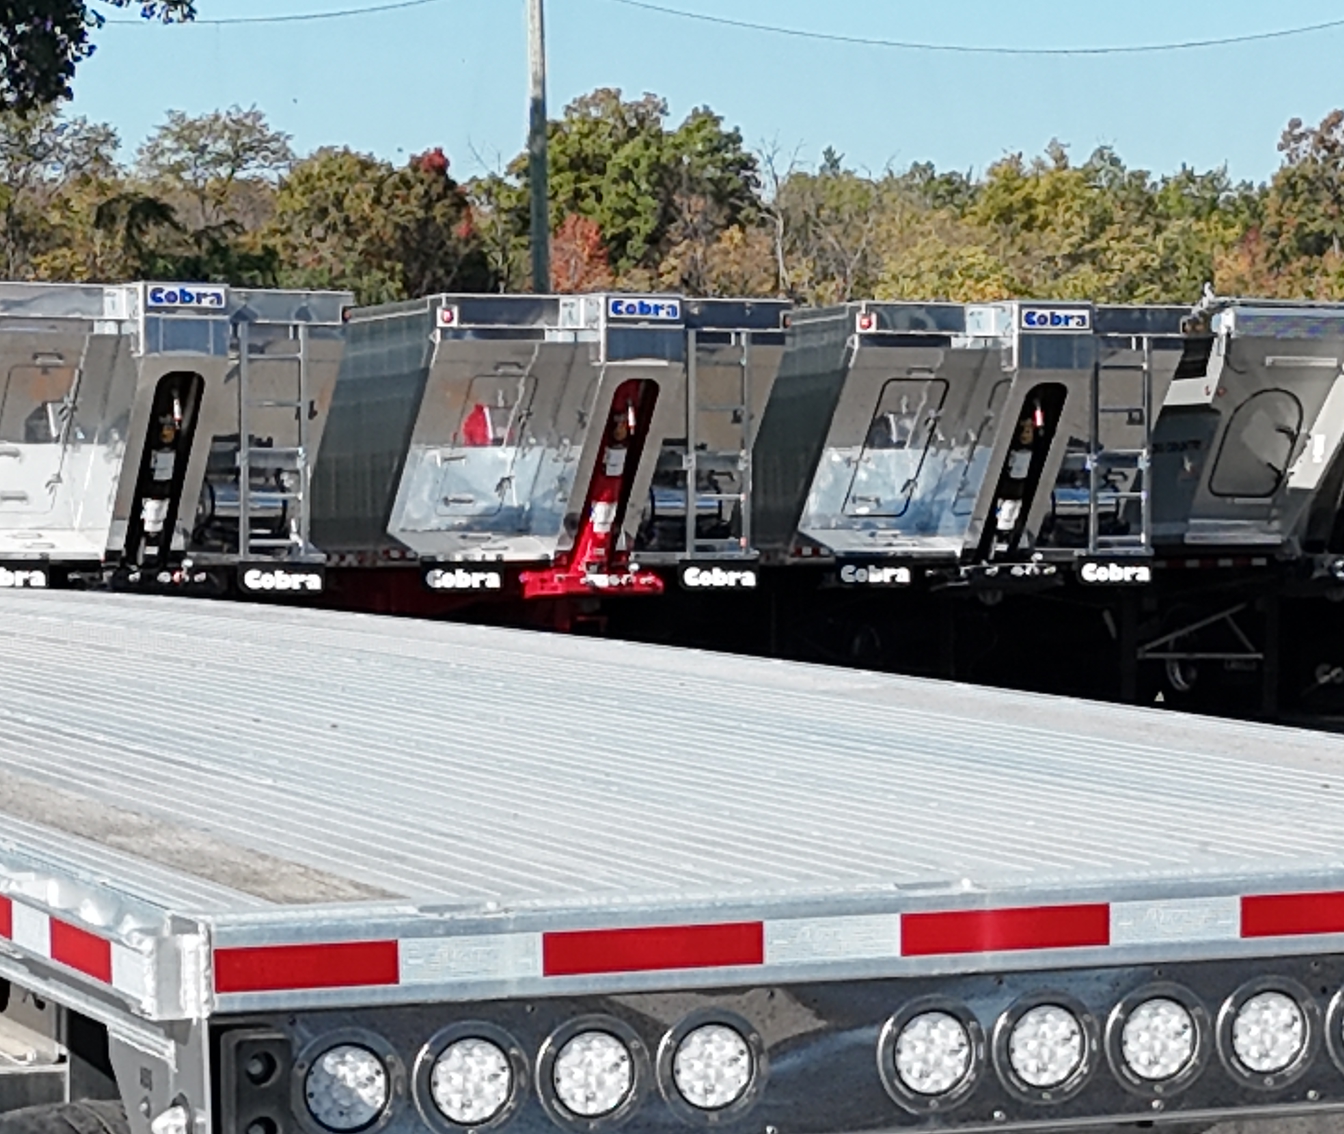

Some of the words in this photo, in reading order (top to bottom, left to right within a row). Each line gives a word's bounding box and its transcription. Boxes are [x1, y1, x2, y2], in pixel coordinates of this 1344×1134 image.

[150, 287, 223, 306] Cobra
[611, 300, 678, 318] Cobra
[1024, 311, 1087, 327] Cobra
[244, 570, 323, 590] Cobra
[426, 569, 501, 589] Cobra
[683, 567, 756, 588] Cobra
[840, 565, 911, 583] Cobra
[1081, 563, 1152, 582] Cobra
